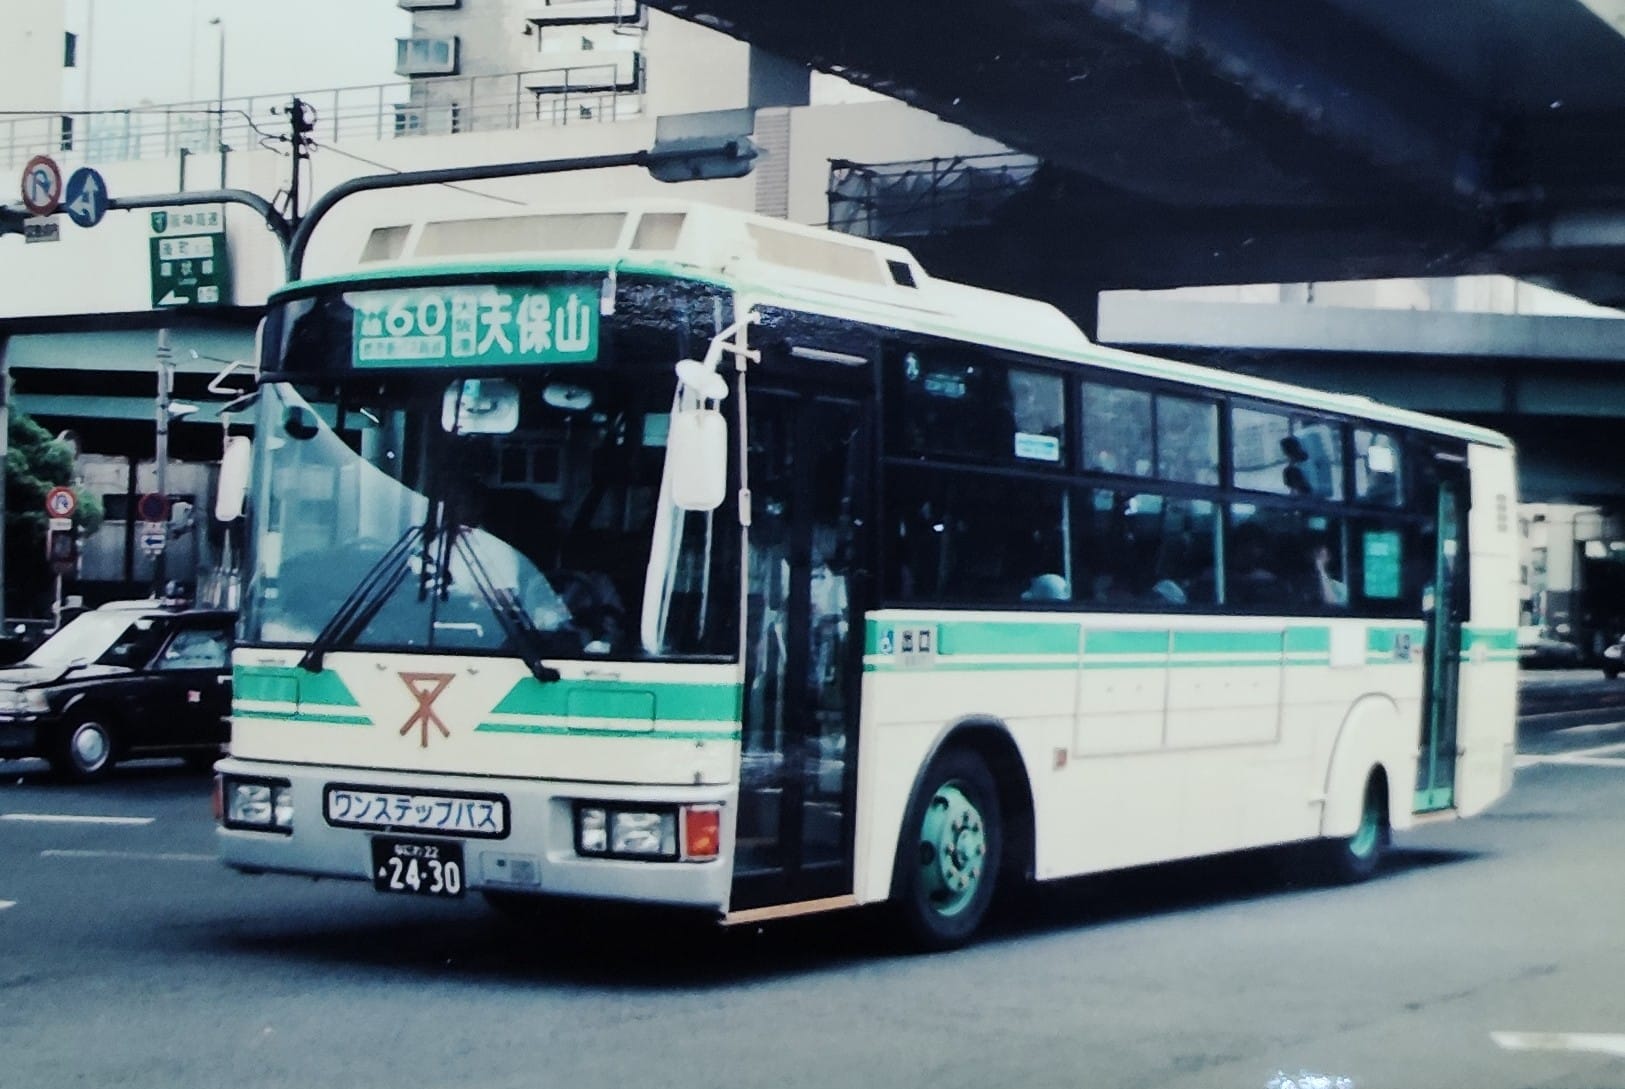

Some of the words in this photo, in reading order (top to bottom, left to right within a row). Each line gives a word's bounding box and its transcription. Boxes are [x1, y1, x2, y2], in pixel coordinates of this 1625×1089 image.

[385, 295, 447, 336] 60
[478, 293, 590, 355] 天保山
[424, 845, 439, 858] 22
